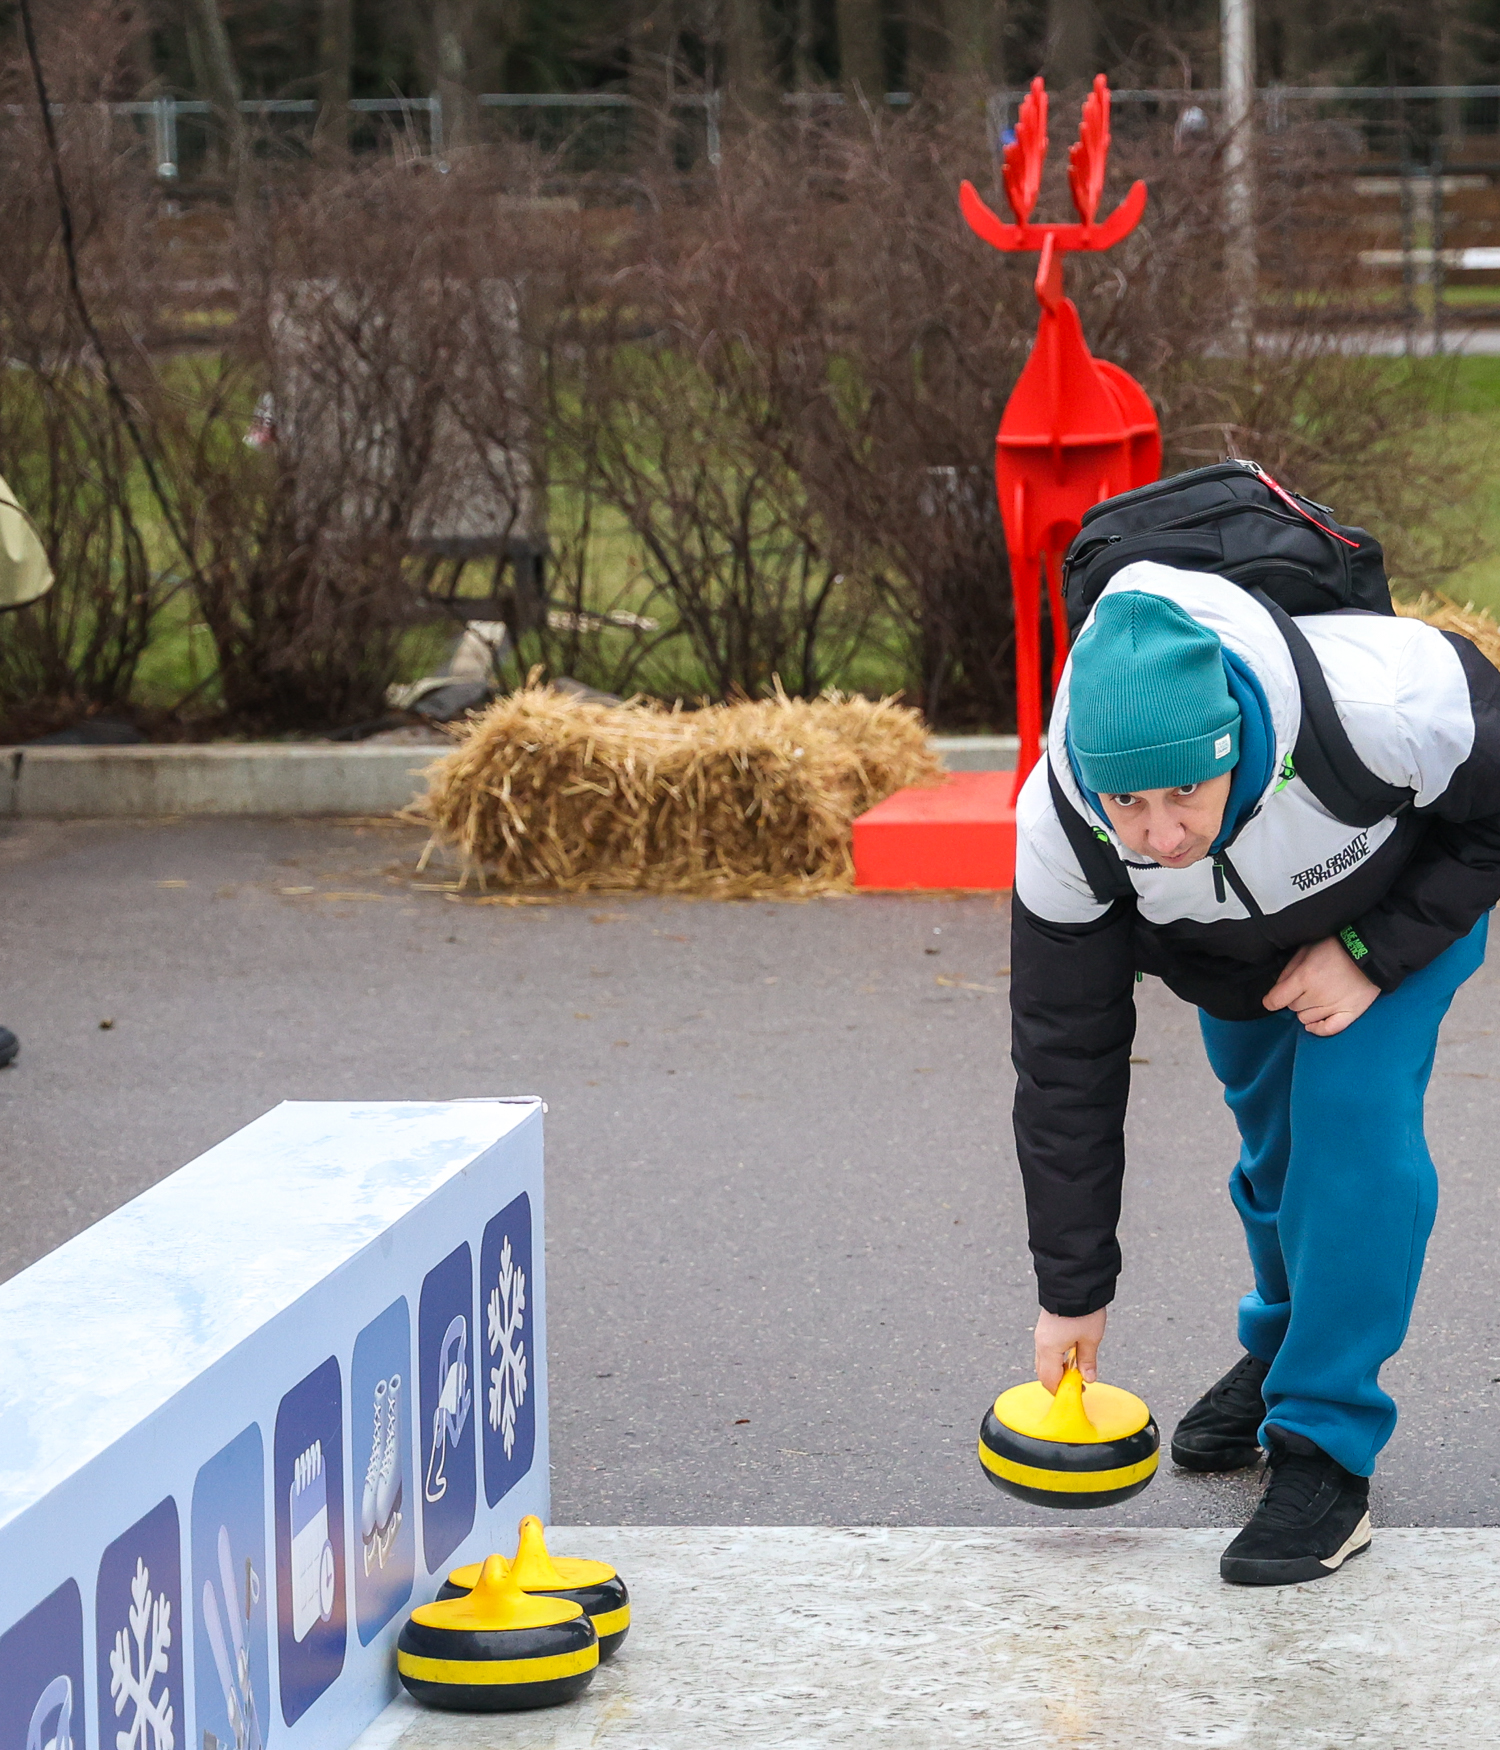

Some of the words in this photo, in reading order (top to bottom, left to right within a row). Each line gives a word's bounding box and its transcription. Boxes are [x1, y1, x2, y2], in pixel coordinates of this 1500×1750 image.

[1290, 863, 1323, 886] ZERO
[1325, 828, 1368, 869] GRAVITY
[1298, 841, 1371, 891] WORLDWIDE
